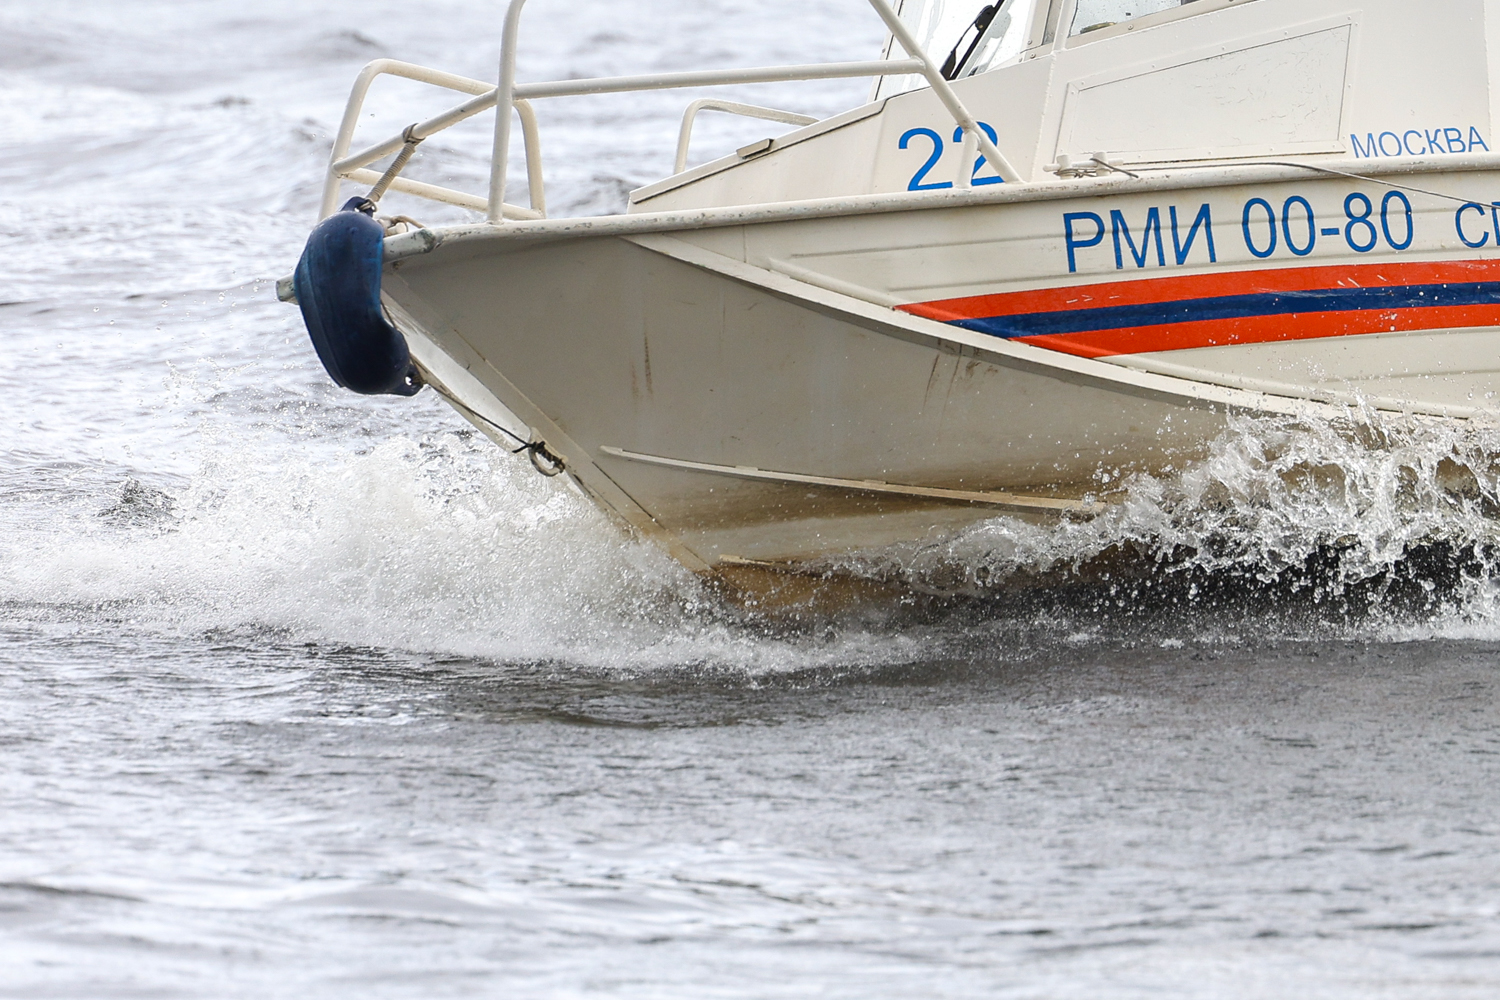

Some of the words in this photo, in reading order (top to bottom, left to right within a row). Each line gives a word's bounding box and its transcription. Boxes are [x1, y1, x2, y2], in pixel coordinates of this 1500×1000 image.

[898, 121, 1005, 191] 22
[1350, 126, 1489, 158] МОСКВА
[1063, 203, 1216, 273] РМИ
[1242, 190, 1414, 258] 00-80
